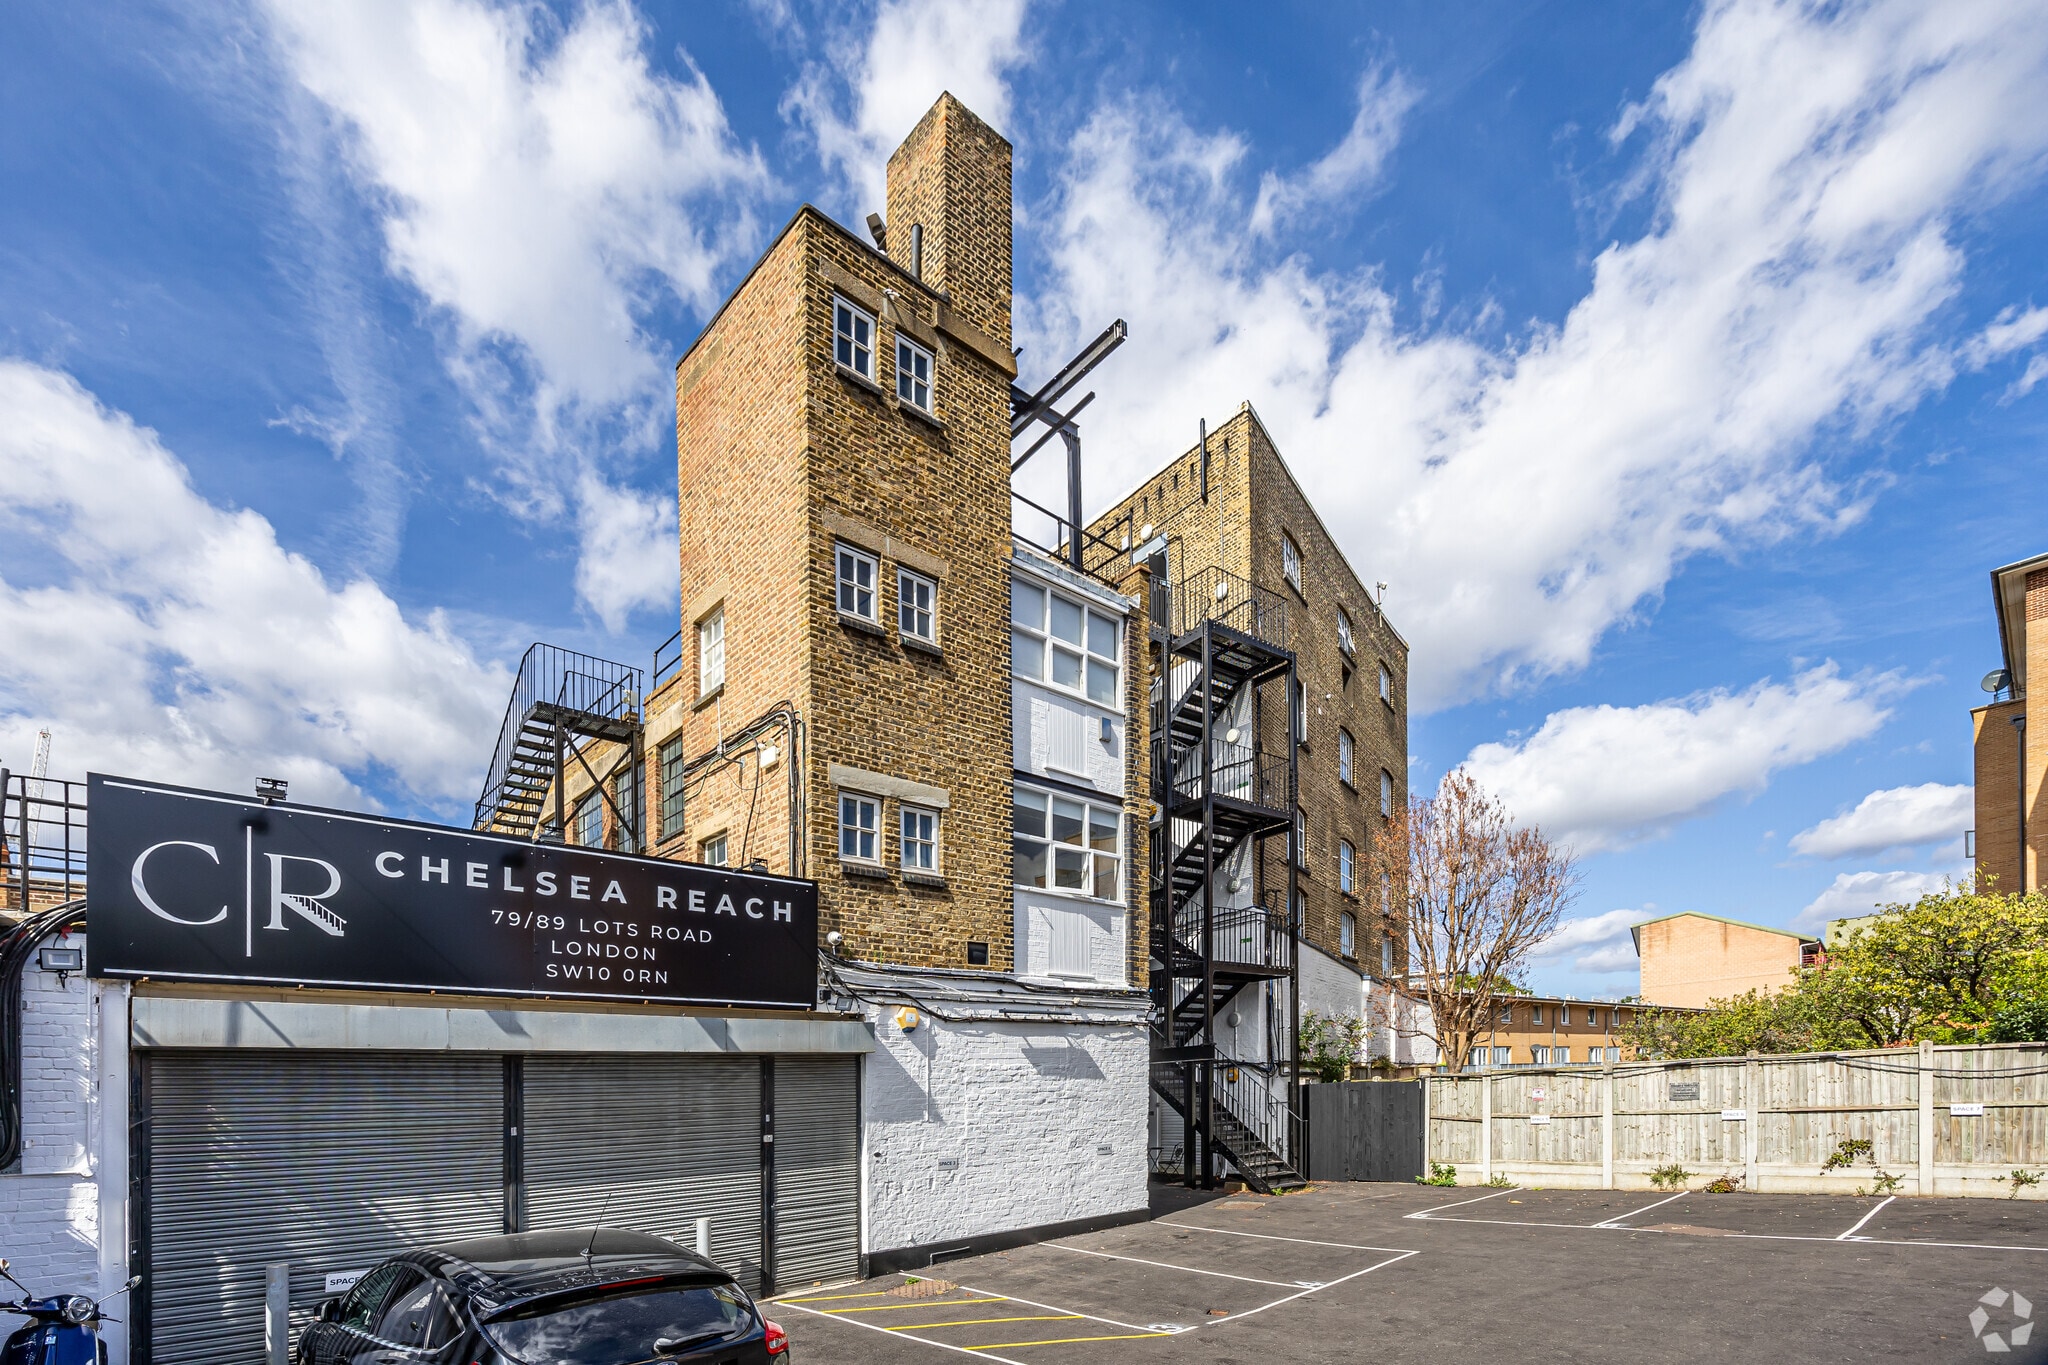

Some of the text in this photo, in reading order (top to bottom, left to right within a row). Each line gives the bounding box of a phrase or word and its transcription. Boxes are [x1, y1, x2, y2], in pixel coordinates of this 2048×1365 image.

[374, 850, 793, 923] CHELSEA REACH
[490, 909, 712, 943] 79/89 LOTS ROAD
[551, 939, 657, 961] LONDON
[546, 963, 611, 981] SW10
